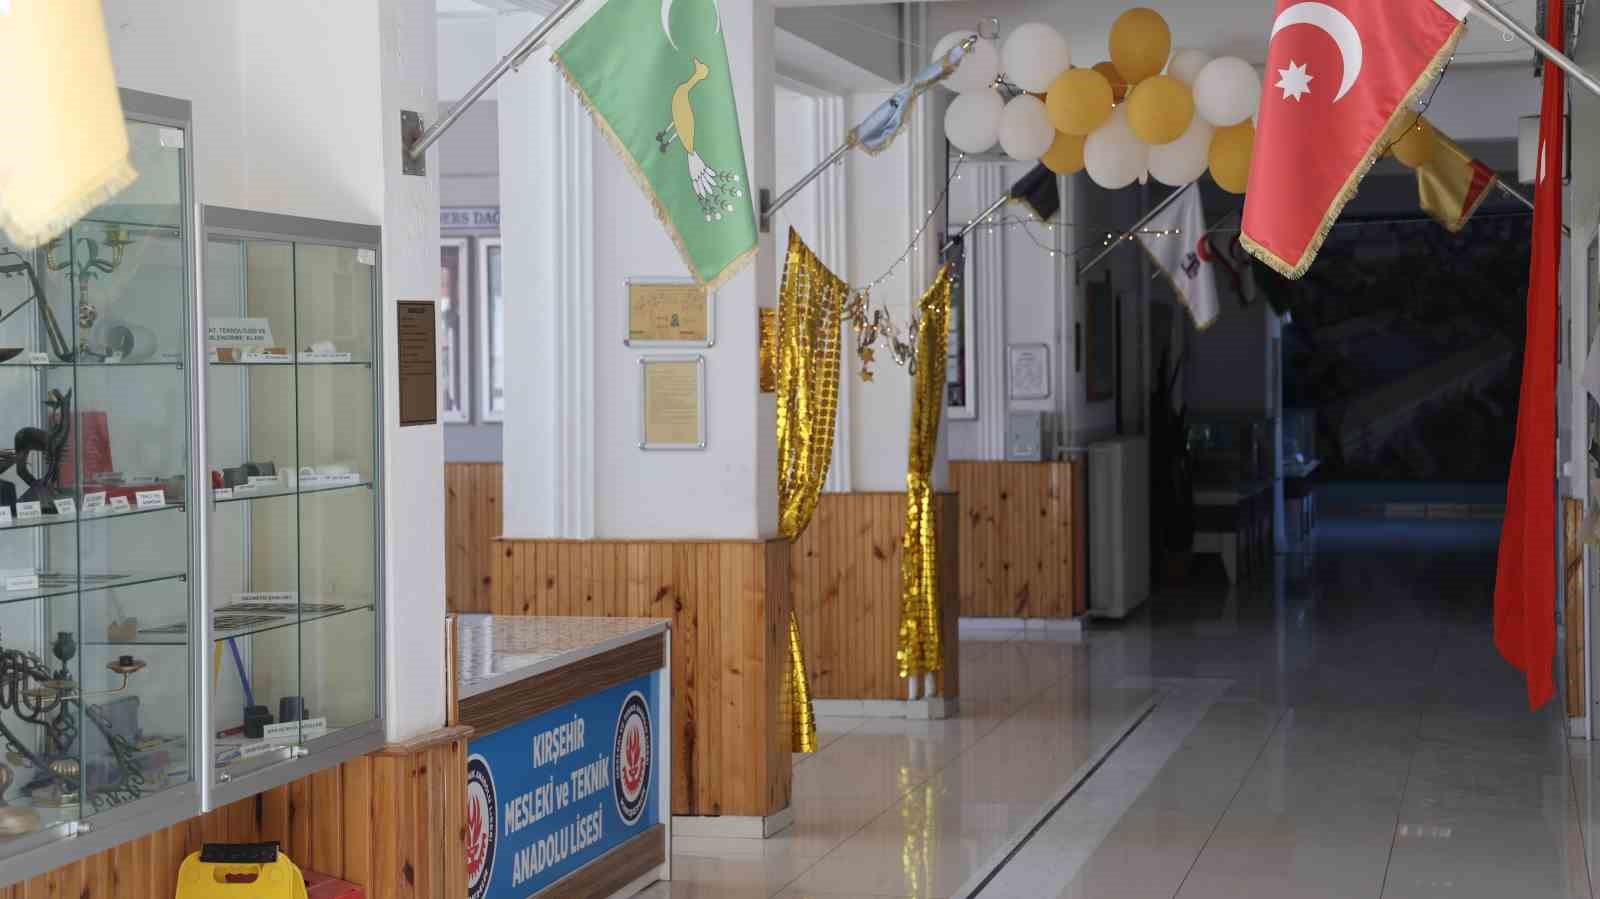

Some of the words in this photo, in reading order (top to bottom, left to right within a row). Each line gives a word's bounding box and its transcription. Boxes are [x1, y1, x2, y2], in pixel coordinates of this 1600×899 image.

[440, 211, 470, 225] ERS
[533, 713, 585, 768] KIRŞEHİR
[505, 776, 554, 837] MESLEKİ
[556, 782, 569, 810] ve
[571, 753, 609, 803] TEKNİK
[512, 830, 568, 888] ANADOLU
[570, 802, 602, 856] LİSESİ
